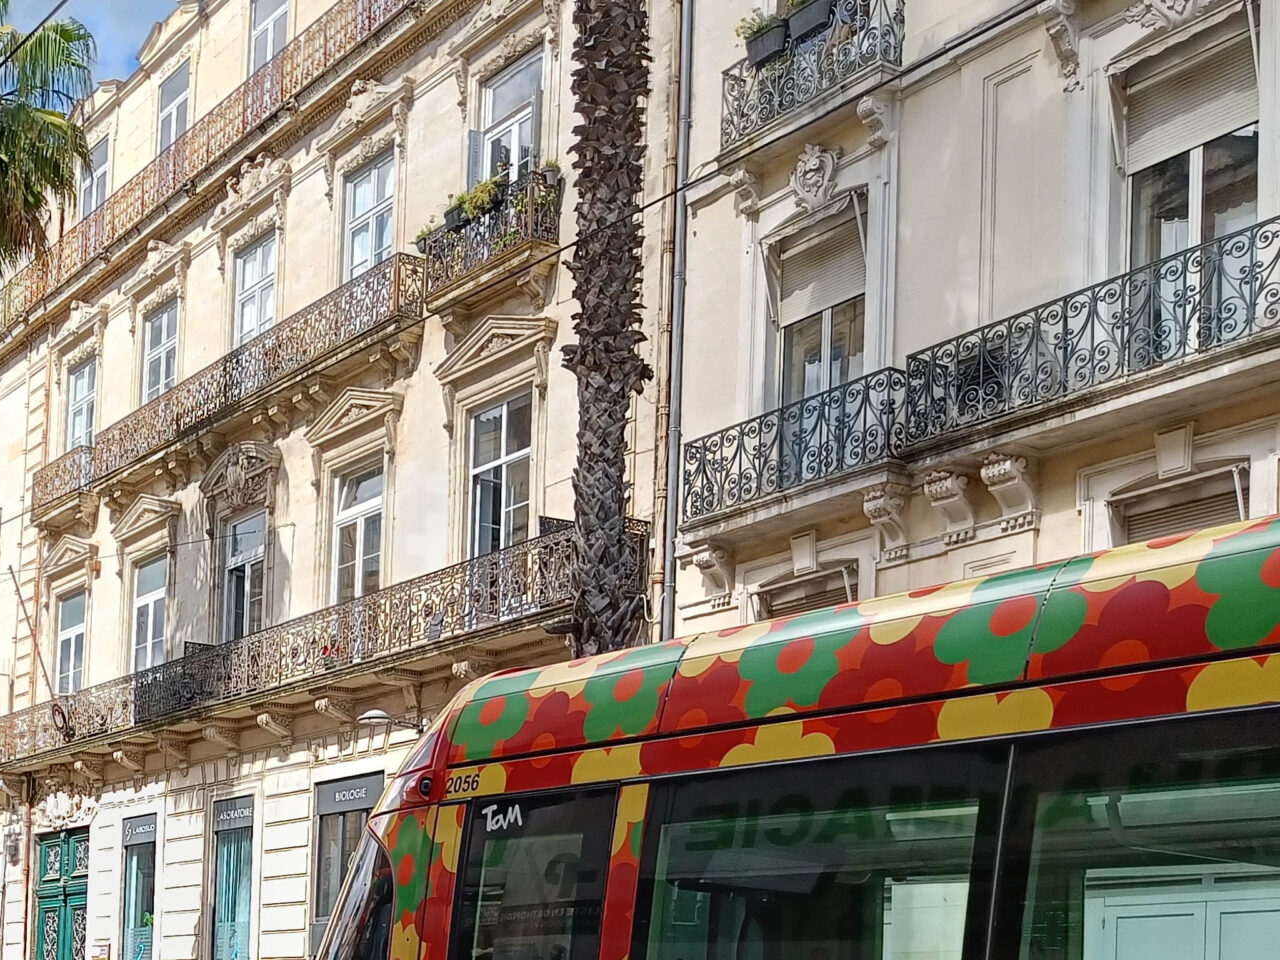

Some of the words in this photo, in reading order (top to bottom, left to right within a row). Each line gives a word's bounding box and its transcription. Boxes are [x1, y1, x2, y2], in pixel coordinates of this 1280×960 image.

[446, 774, 480, 794] 2056
[335, 787, 367, 802] BIOLOGIE
[217, 807, 252, 821] LABORATOIRE
[132, 824, 155, 834] LABOSUD
